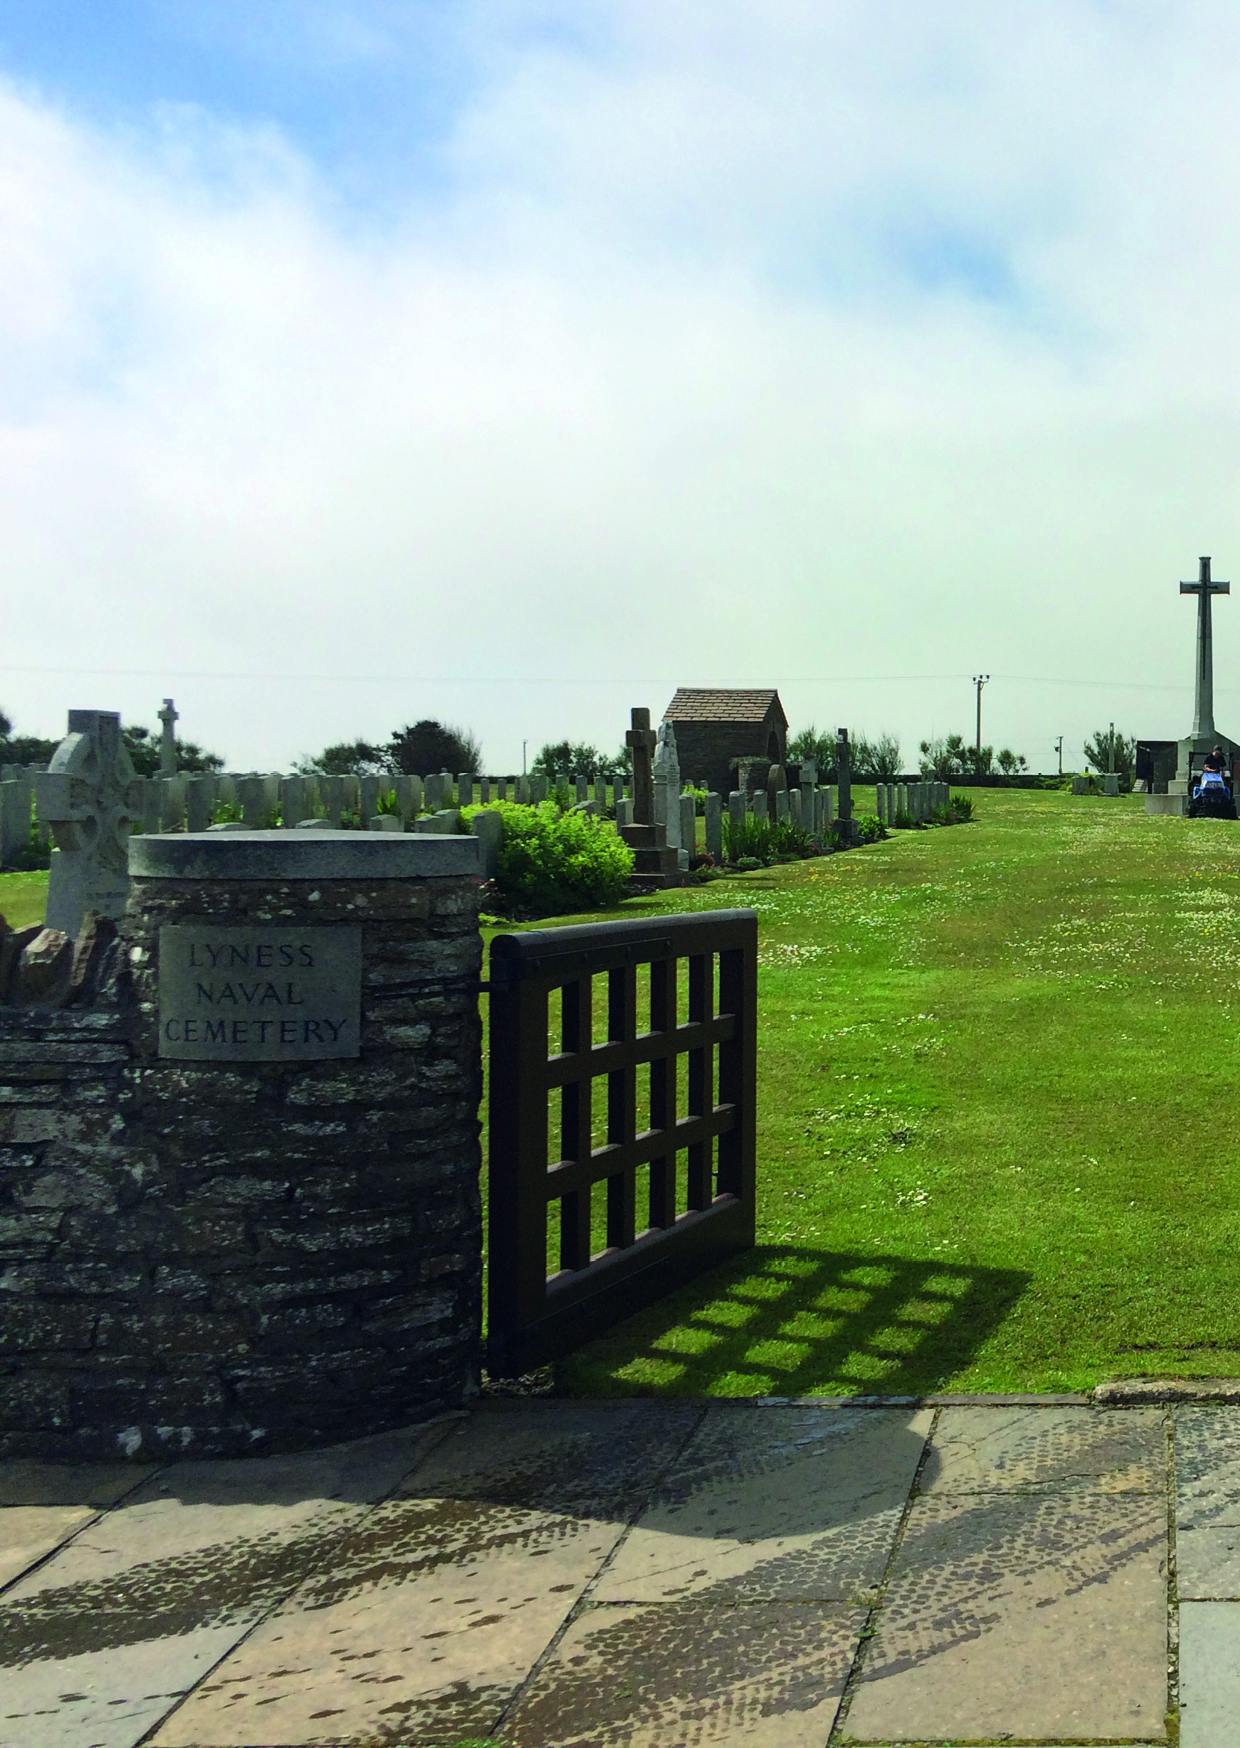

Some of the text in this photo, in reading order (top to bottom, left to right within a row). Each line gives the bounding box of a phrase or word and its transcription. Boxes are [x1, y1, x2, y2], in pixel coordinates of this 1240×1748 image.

[188, 943, 315, 968] LYNESS
[196, 982, 304, 1006] NAVAL
[164, 1018, 348, 1044] CEMETERY
